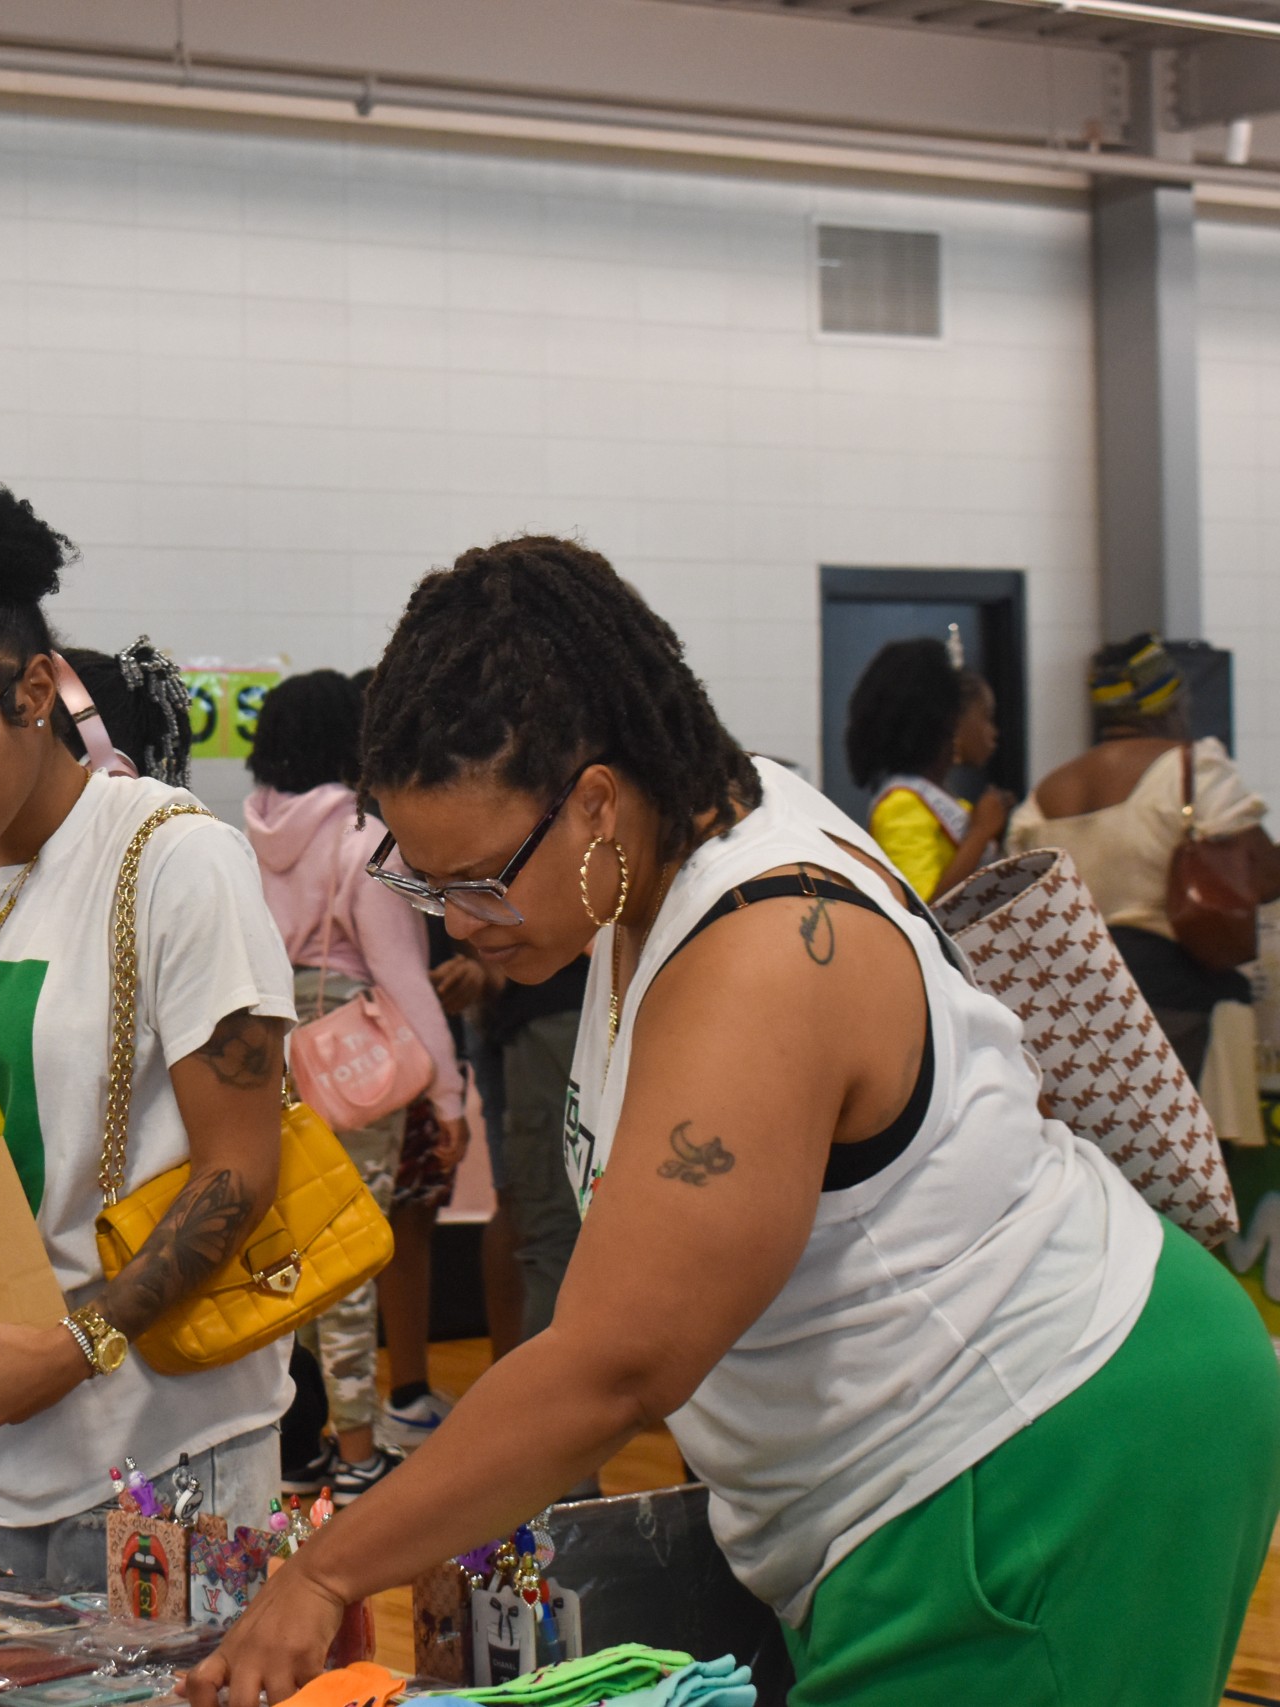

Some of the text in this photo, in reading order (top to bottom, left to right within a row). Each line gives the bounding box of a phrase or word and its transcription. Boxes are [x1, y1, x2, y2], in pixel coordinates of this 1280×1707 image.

[1040, 869, 1069, 898] MK
[987, 908, 1020, 935] MK
[1025, 902, 1058, 932] MK
[1061, 897, 1086, 926] MK
[969, 938, 1003, 967] MK
[1008, 936, 1041, 964] MK
[1044, 931, 1077, 961] MK
[1080, 925, 1104, 955] MK
[989, 967, 1022, 996] MK
[1027, 964, 1060, 992] MK
[1064, 959, 1097, 989] MK
[1047, 992, 1080, 1021] MK
[1083, 987, 1115, 1017] MK
[1031, 1024, 1064, 1055] MK
[1067, 1019, 1100, 1049] MK
[1103, 1014, 1134, 1045] MK
[1051, 1053, 1084, 1083] MK
[1087, 1048, 1119, 1078] MK
[1122, 1041, 1152, 1072] MK
[1071, 1082, 1104, 1112] MK
[1107, 1076, 1138, 1106] MK
[1142, 1069, 1169, 1099] MK
[1091, 1109, 1123, 1139] MK
[1127, 1103, 1157, 1134] MK
[1160, 1096, 1186, 1126] MK
[1110, 1137, 1143, 1166] MK
[1147, 1132, 1177, 1162] MK
[1180, 1123, 1202, 1154] MK
[1167, 1159, 1197, 1188] MK
[1186, 1185, 1216, 1214] MK
